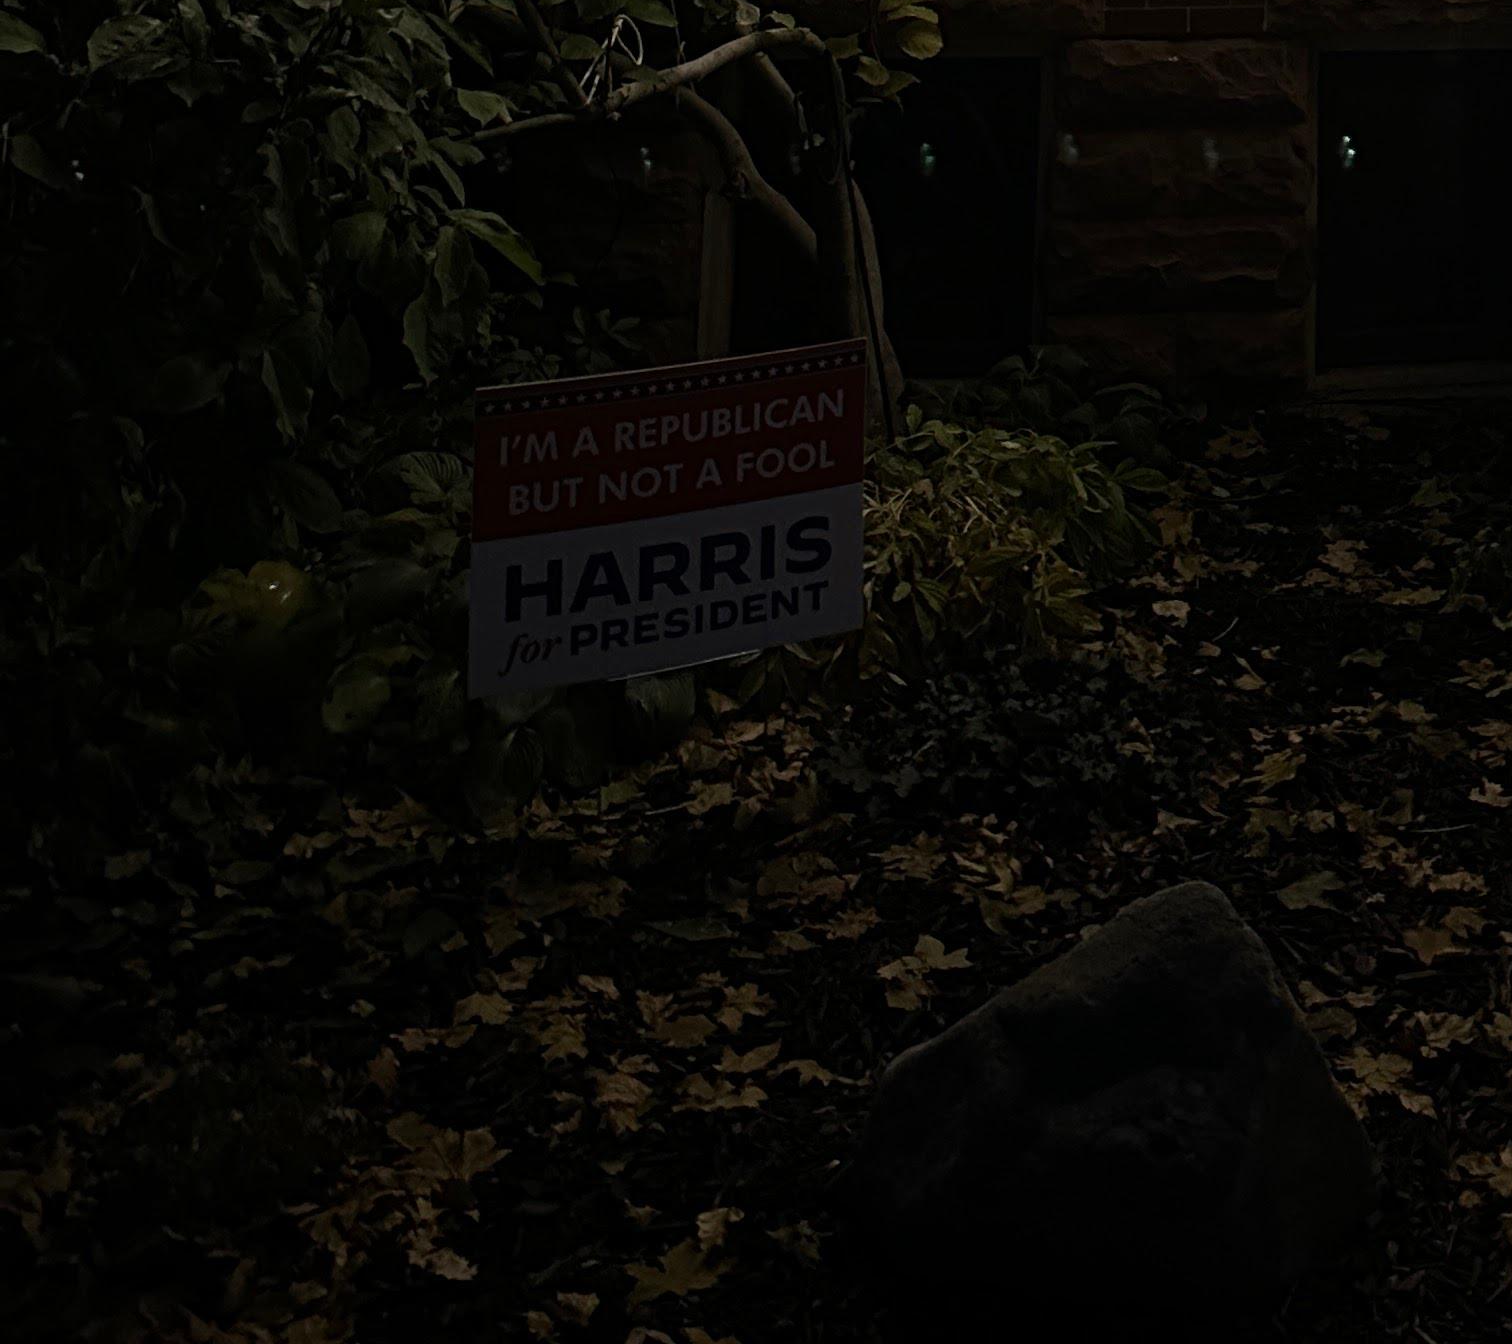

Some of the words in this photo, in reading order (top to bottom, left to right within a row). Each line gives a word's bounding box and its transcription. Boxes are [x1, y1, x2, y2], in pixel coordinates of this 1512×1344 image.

[499, 431, 559, 468] I'M
[572, 425, 600, 459] A
[614, 388, 845, 453] REPUBLICAN
[508, 476, 583, 516] BUT
[598, 462, 684, 506] NOT
[696, 456, 724, 489] A
[736, 439, 836, 483] FOOL
[504, 515, 832, 622] HARRIS
[497, 633, 561, 677] for
[570, 581, 829, 656] PRESIDENT
